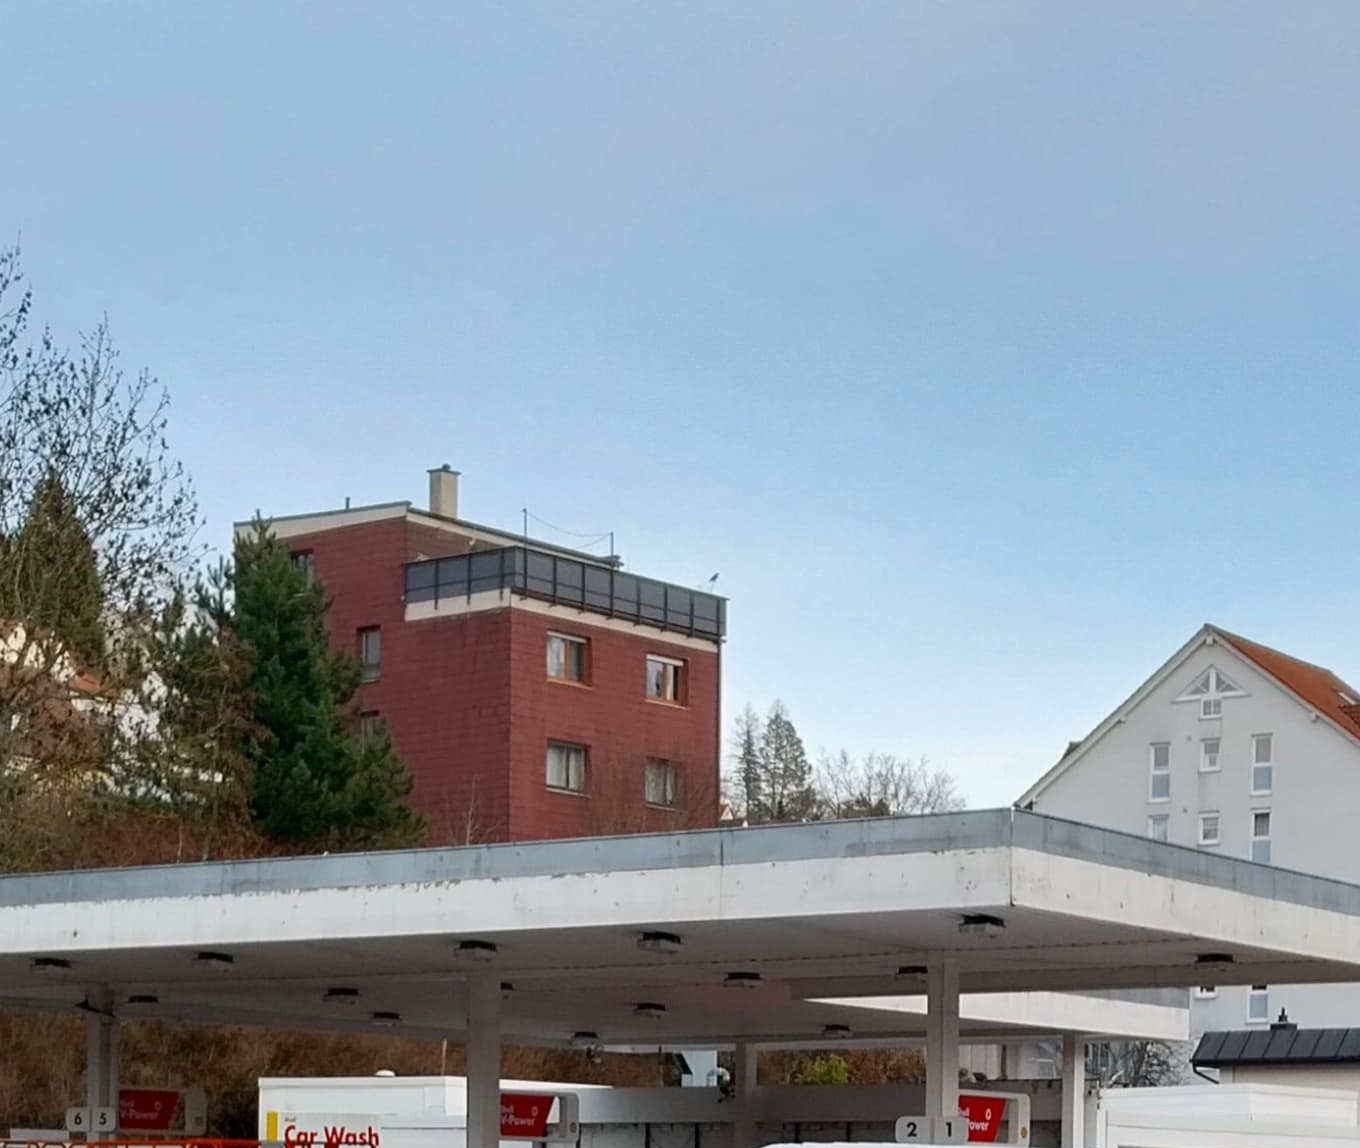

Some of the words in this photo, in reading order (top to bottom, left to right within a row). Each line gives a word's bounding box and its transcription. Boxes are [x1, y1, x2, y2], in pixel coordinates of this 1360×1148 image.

[74, 1112, 82, 1126] 6
[98, 1112, 107, 1126] 5
[284, 1125, 318, 1146] Car
[324, 1126, 380, 1147] Wash
[906, 1121, 918, 1137] 2
[946, 1121, 953, 1137] 1
